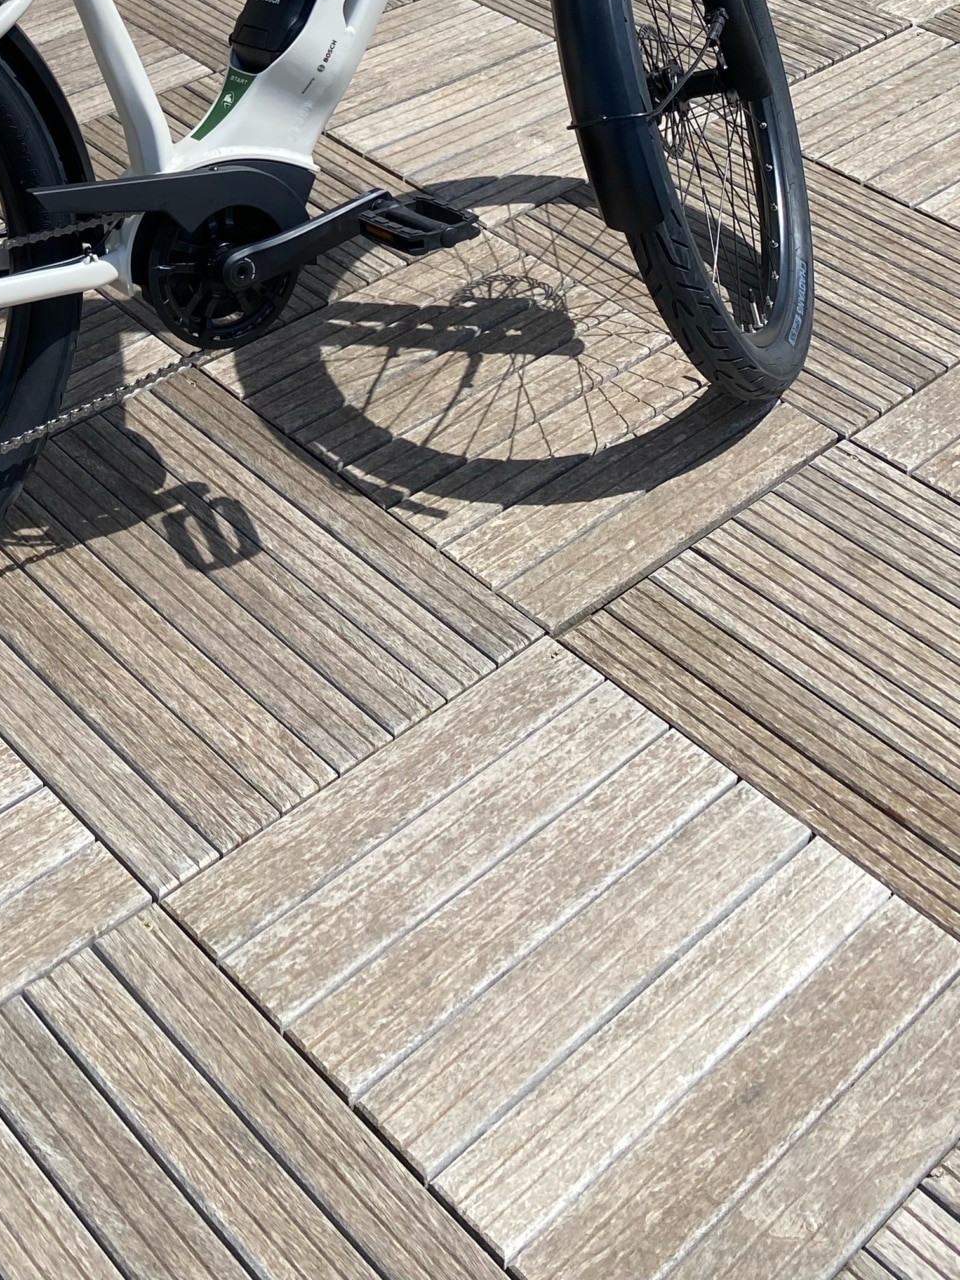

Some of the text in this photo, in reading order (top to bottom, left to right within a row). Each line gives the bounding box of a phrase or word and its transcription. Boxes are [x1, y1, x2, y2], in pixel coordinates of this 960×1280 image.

[323, 39, 338, 63] BOSCH
[230, 75, 248, 85] START
[793, 260, 807, 318] CHAOYANG
